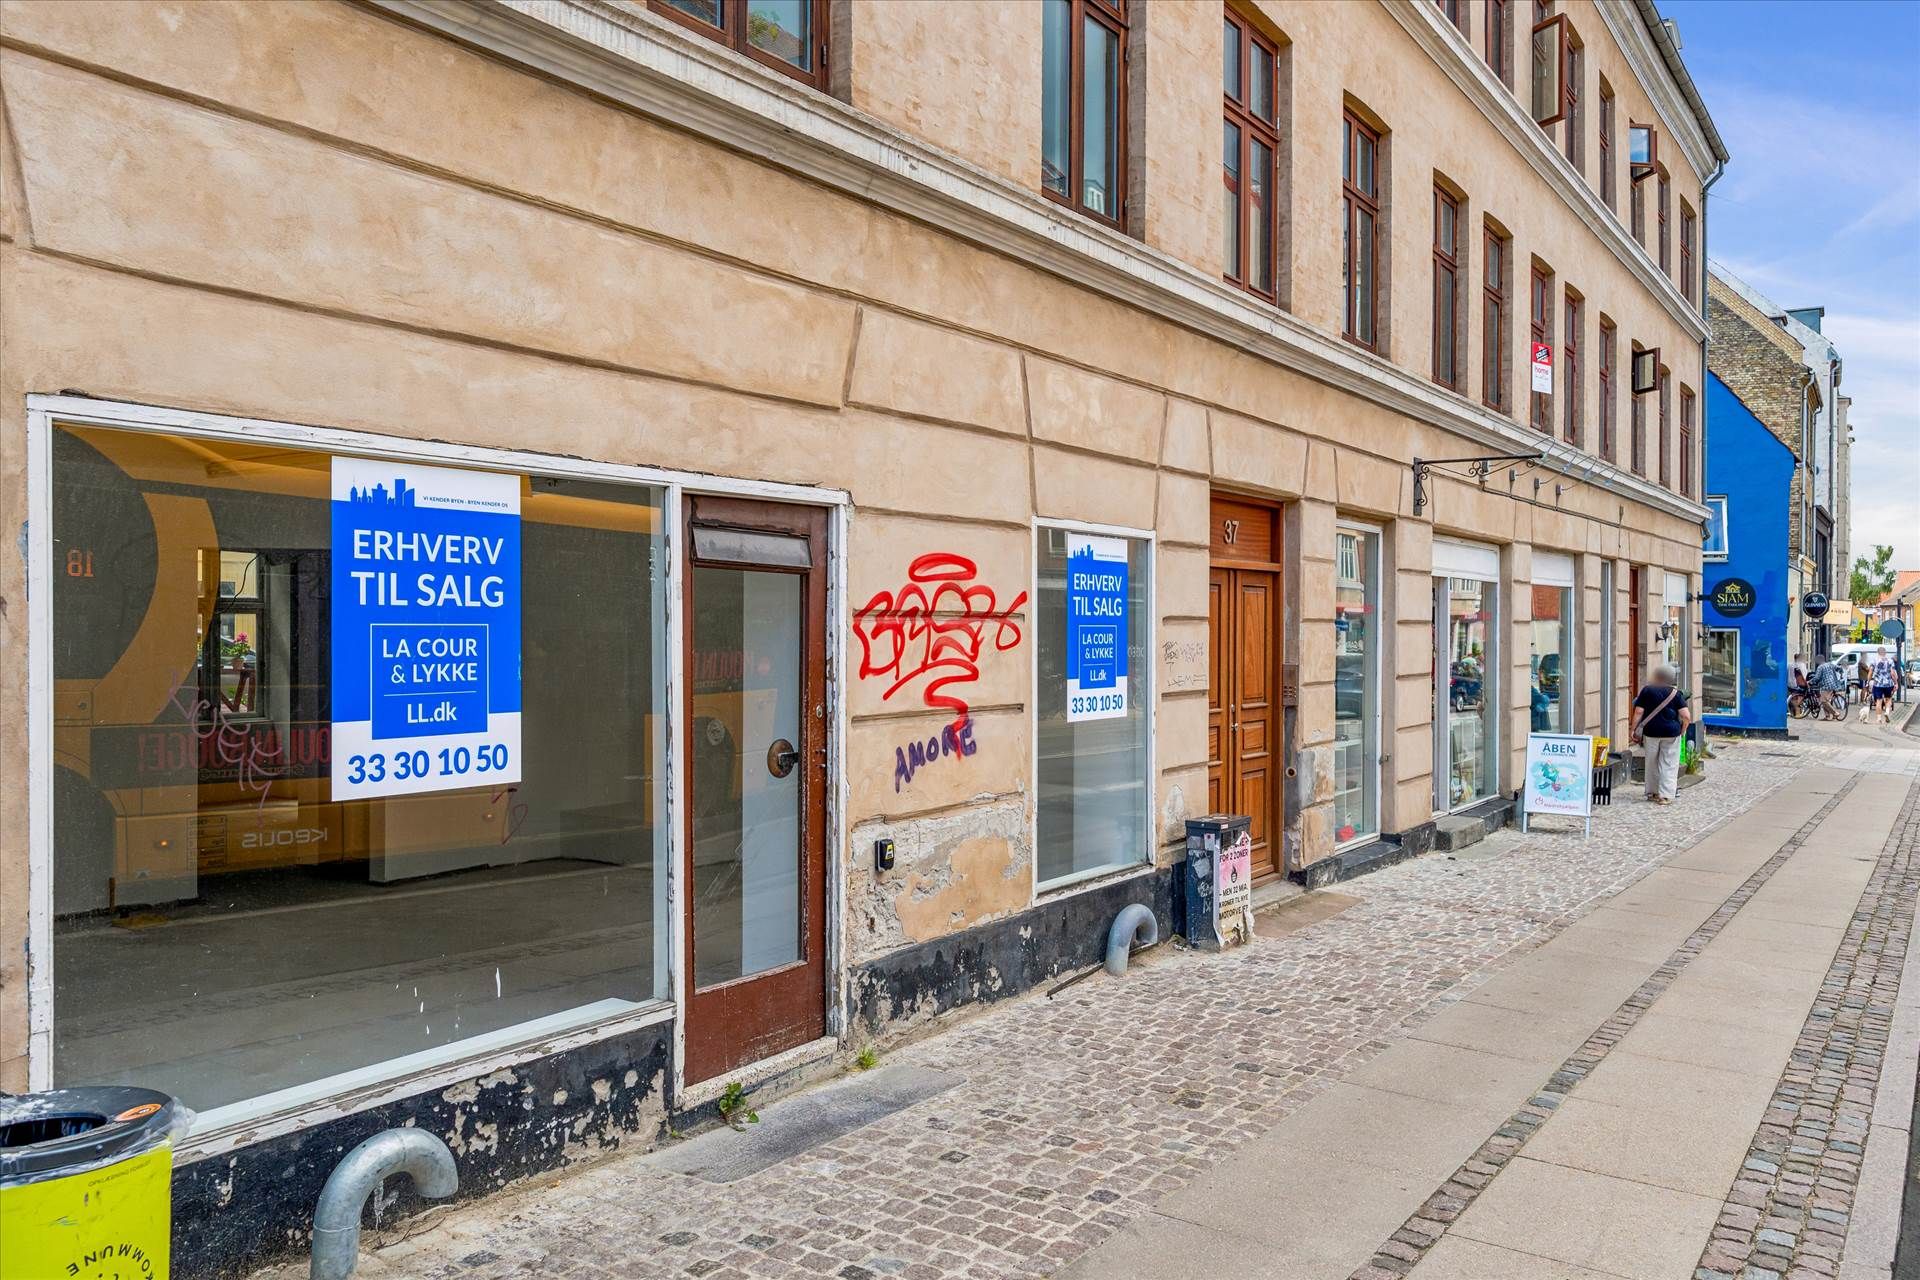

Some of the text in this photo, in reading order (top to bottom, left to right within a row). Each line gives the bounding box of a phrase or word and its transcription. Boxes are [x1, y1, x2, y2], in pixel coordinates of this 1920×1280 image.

[1223, 519, 1240, 544] 37
[353, 528, 504, 565] ERHVERV
[351, 571, 505, 608] TIL SALG
[1073, 572, 1123, 592] ERHVERV
[1072, 596, 1123, 617] TIL SALG
[1717, 593, 1749, 604] SIAM
[383, 637, 478, 658] LA COUR
[1082, 633, 1114, 645] LA COUR
[1085, 647, 1114, 659] & LYKKE
[391, 662, 478, 684] & LYKKE
[1090, 668, 1107, 682] LL.dk
[406, 701, 458, 724] LL.dk
[1071, 694, 1123, 714] 33 30 10 50
[1542, 741, 1576, 754] ÅBEN
[347, 743, 509, 785] 33 30 10 50
[1219, 852, 1230, 863] FOR
[1222, 886, 1233, 897] MEN
